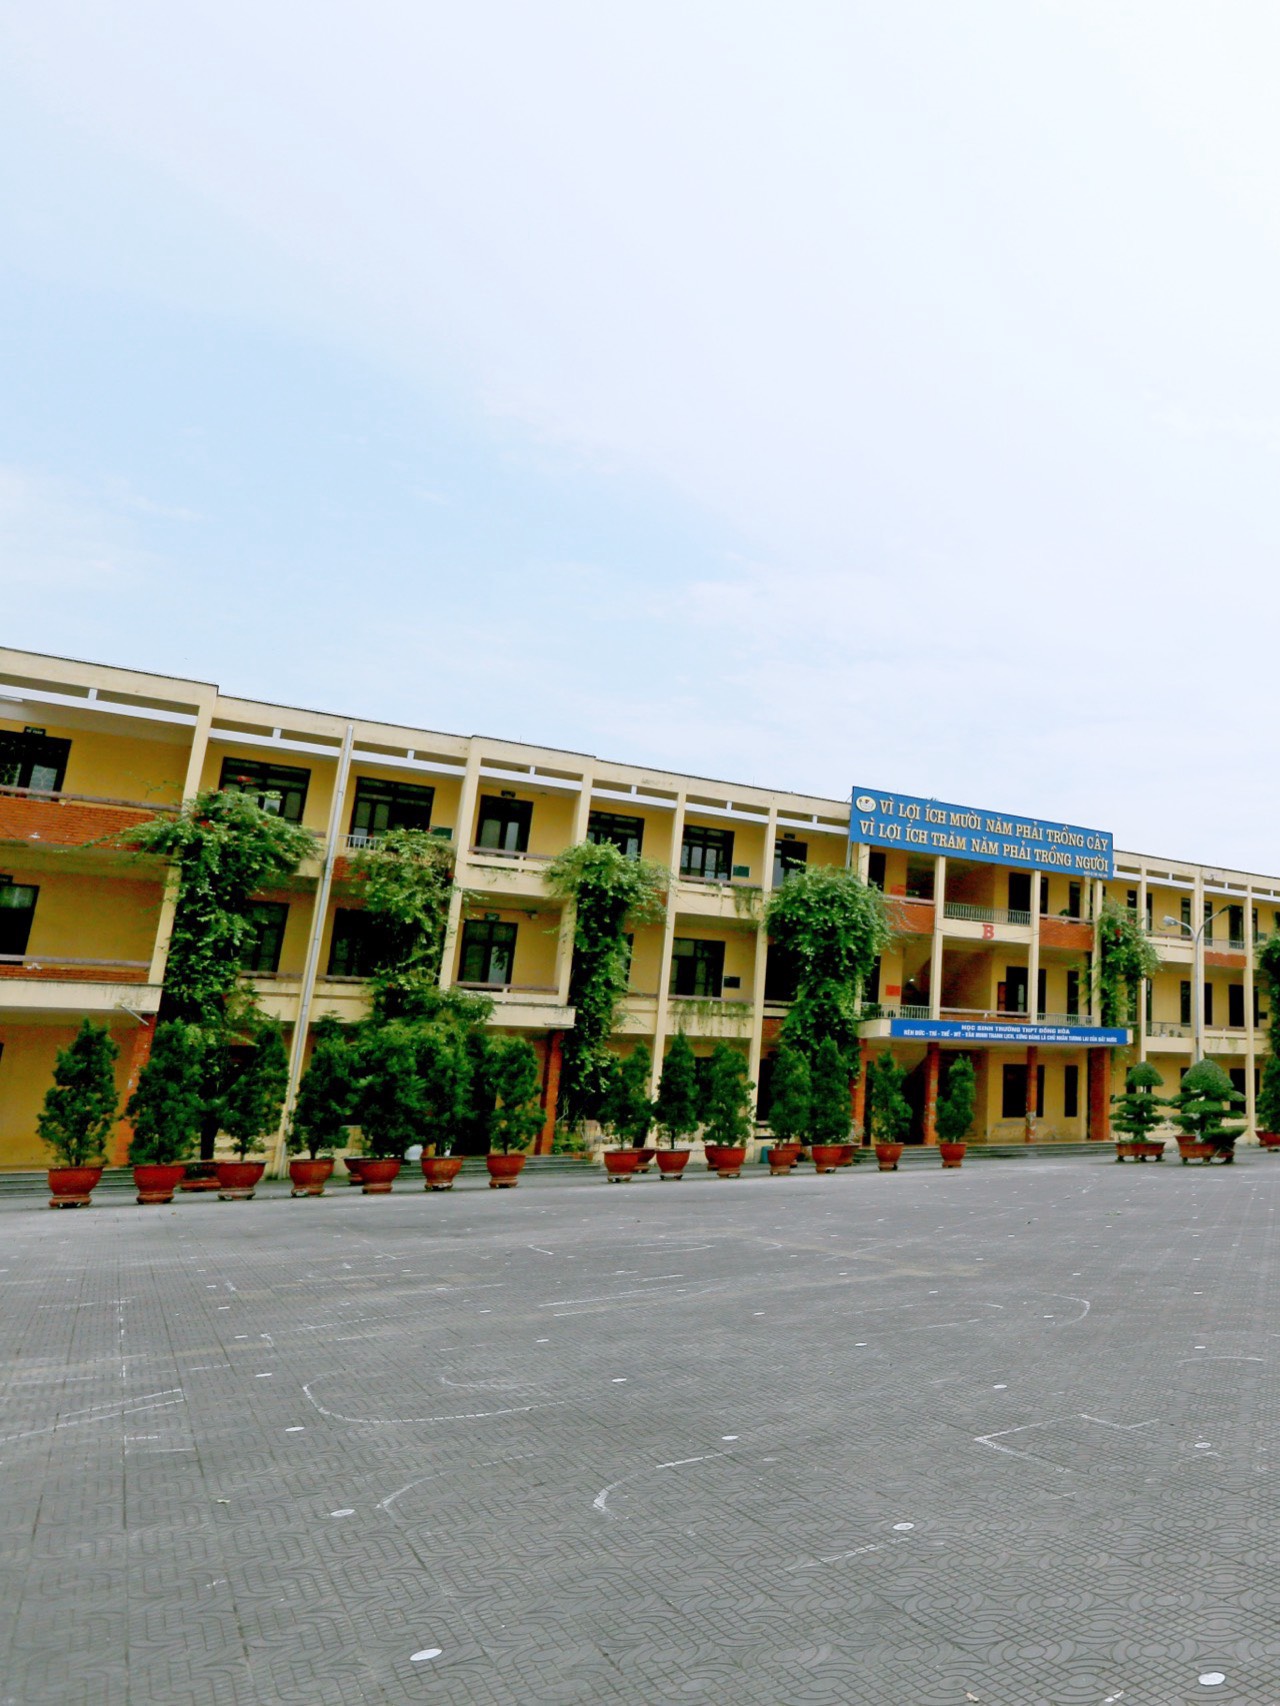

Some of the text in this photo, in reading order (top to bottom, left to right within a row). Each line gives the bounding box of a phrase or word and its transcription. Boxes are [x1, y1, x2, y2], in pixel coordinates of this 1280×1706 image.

[860, 817, 1109, 872] VÌ LỢI ÍCH TRĂM NĂM PHẢI TRỒNG NGƯỜI
[880, 797, 1108, 852] VÌ LỢI ÍCH MƯỜI NĂM PHẢI TRỒNG CÂY
[982, 924, 994, 940] B
